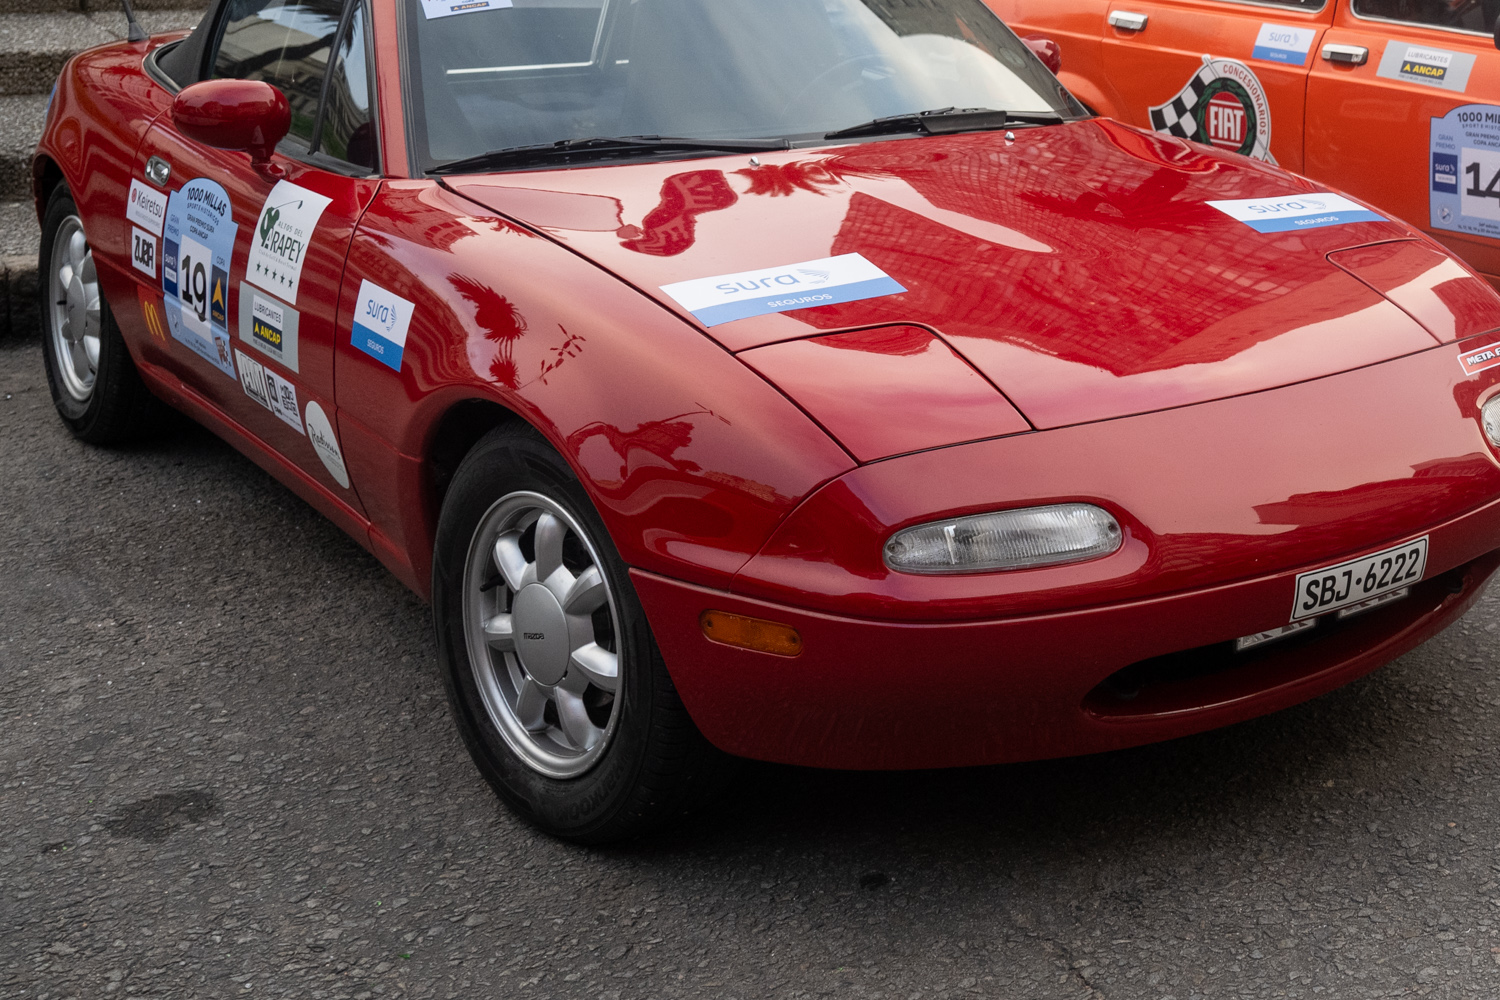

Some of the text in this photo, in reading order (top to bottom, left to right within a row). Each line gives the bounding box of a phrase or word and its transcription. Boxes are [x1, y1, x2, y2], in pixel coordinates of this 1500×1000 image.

[461, 1, 488, 10] ANCAP
[1268, 31, 1291, 44] sura
[1407, 51, 1449, 64] LUBRICANTES
[1412, 64, 1444, 77] ANCAP
[1223, 64, 1267, 136] CONCESIONARIOS
[1209, 105, 1244, 142] FIAT
[1457, 112, 1483, 123] 1000
[1438, 133, 1453, 142] GRAN
[1465, 130, 1480, 138] GRAN
[1480, 132, 1500, 142] PREMIO
[1473, 138, 1488, 146] COPA
[1435, 141, 1456, 150] PREMIO
[1434, 163, 1450, 172] sura
[136, 190, 163, 218] Keiretsu
[187, 187, 227, 217] 1000 MILLAS
[1245, 198, 1306, 217] sura
[170, 213, 180, 225] GRAN
[186, 213, 215, 234] GRAN PREMIO SURA
[1293, 214, 1340, 228] SEGUROS
[167, 224, 180, 237] PREMIO
[189, 225, 209, 241] COPA ANCAP
[277, 220, 303, 238] ALTOS DEL
[265, 227, 305, 264] ARAPEY
[165, 253, 174, 266] sura
[181, 254, 207, 323] 19
[715, 273, 801, 296] sura
[767, 292, 833, 309] SEGUROS
[253, 301, 282, 324] LUBRICANTES
[366, 299, 389, 324] sura
[260, 325, 281, 345] ANCAP
[367, 338, 385, 355] SEGUROS
[1466, 350, 1495, 367] META
